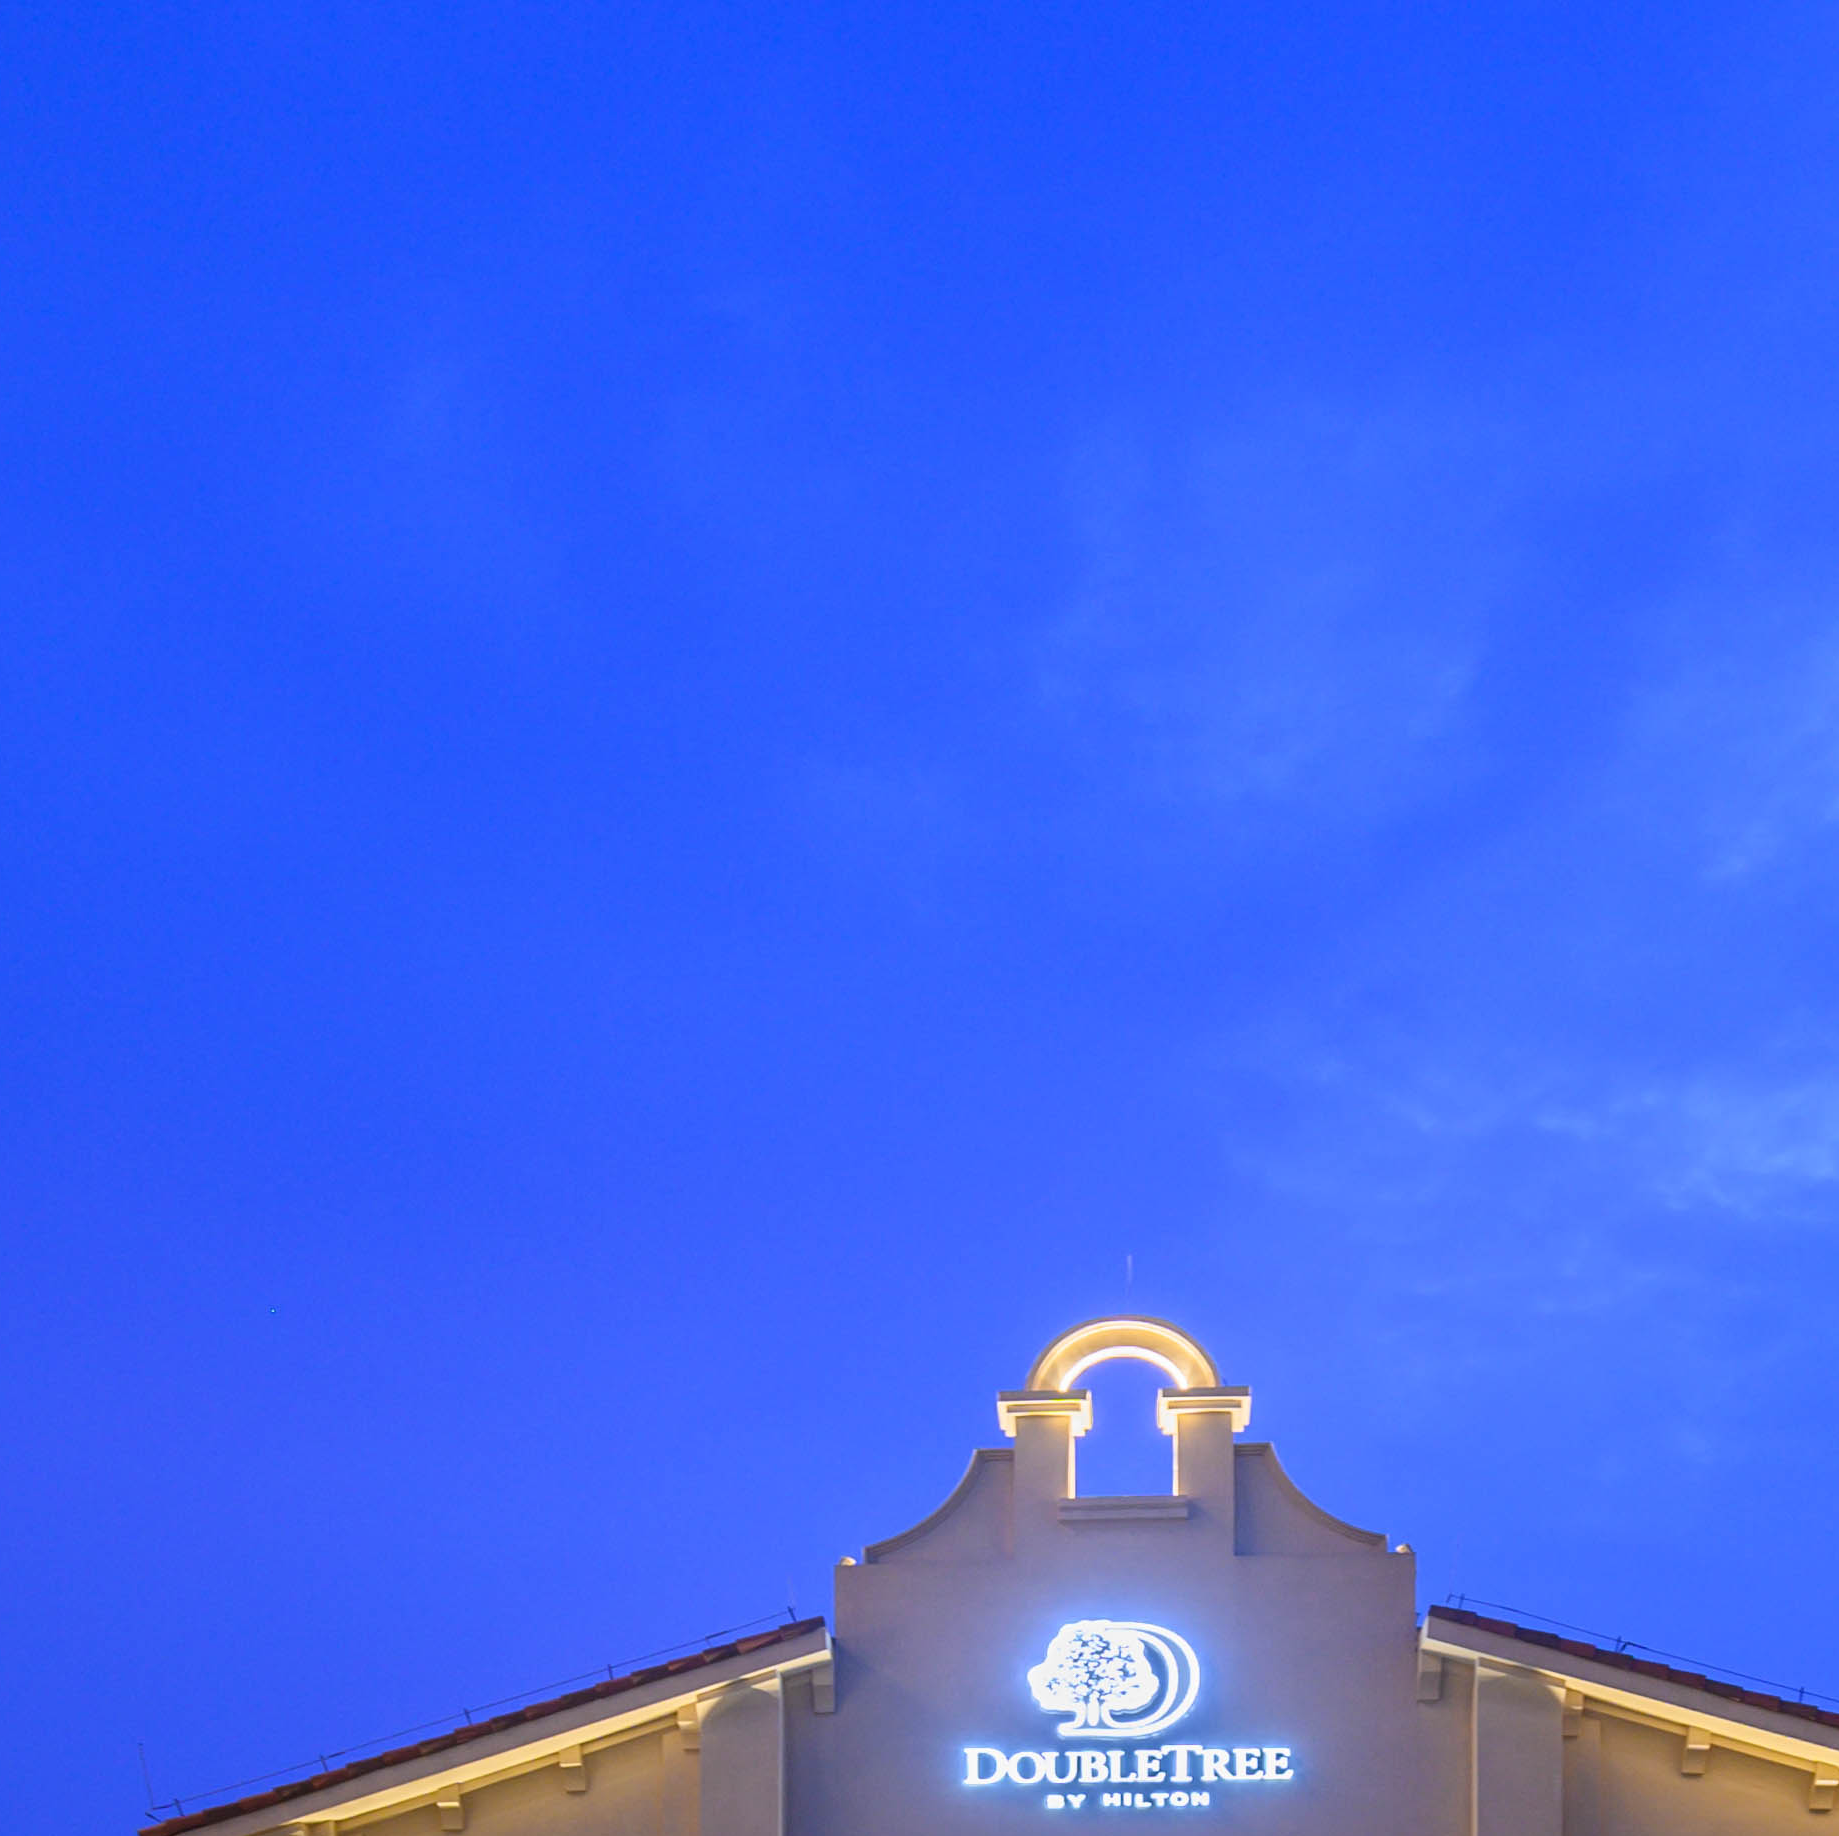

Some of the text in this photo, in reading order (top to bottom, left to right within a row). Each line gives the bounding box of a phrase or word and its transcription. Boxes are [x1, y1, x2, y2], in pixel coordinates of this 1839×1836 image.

[963, 1744, 1294, 1785] DOUBLETREE
[1046, 1791, 1210, 1810] BY HILTON
